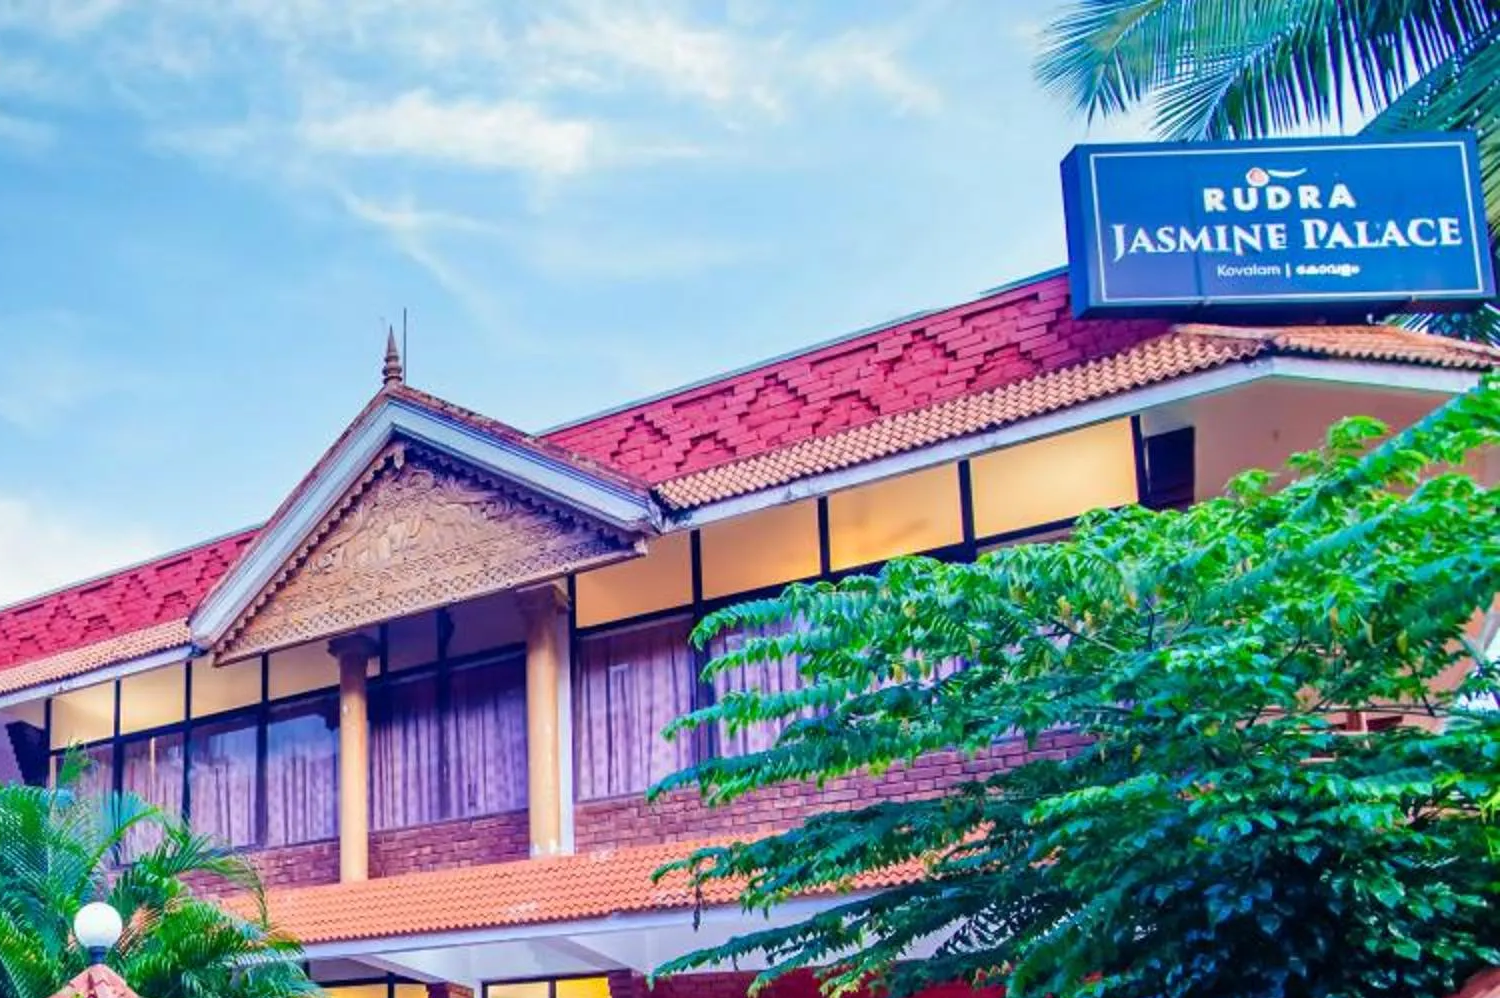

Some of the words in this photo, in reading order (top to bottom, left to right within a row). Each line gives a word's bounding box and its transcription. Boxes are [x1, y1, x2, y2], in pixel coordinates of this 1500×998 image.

[1203, 184, 1356, 212] RUDRA
[1113, 223, 1287, 261] JASMINE
[1303, 217, 1462, 249] PALACE
[1217, 264, 1281, 277] Kovalam
